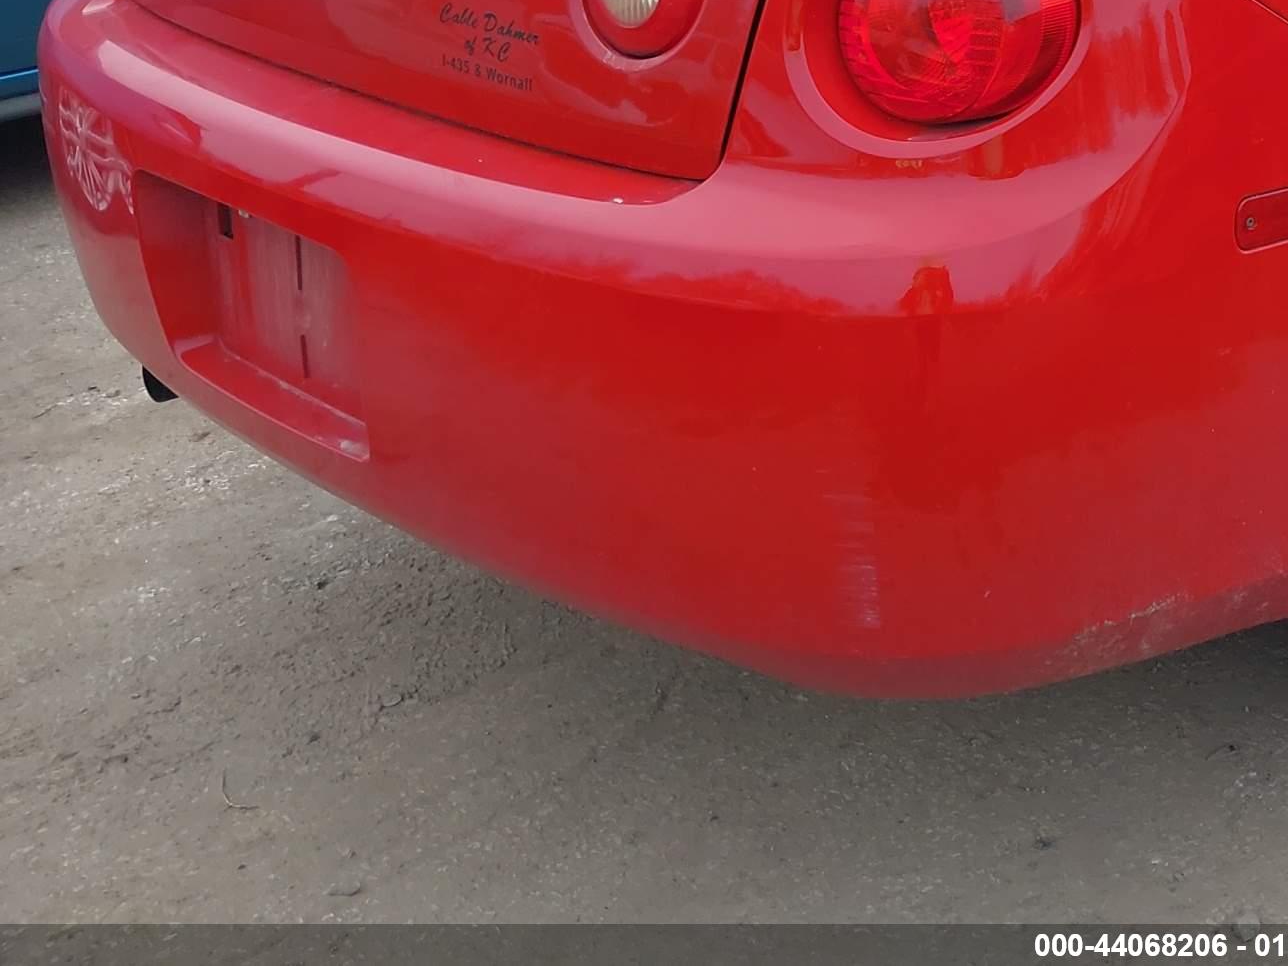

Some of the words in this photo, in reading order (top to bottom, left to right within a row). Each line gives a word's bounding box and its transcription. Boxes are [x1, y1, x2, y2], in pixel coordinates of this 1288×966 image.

[440, 2, 479, 28] Cable
[484, 13, 539, 45] Dahmer
[465, 36, 478, 56] of
[483, 37, 511, 63] KC
[487, 67, 533, 91] Wornall
